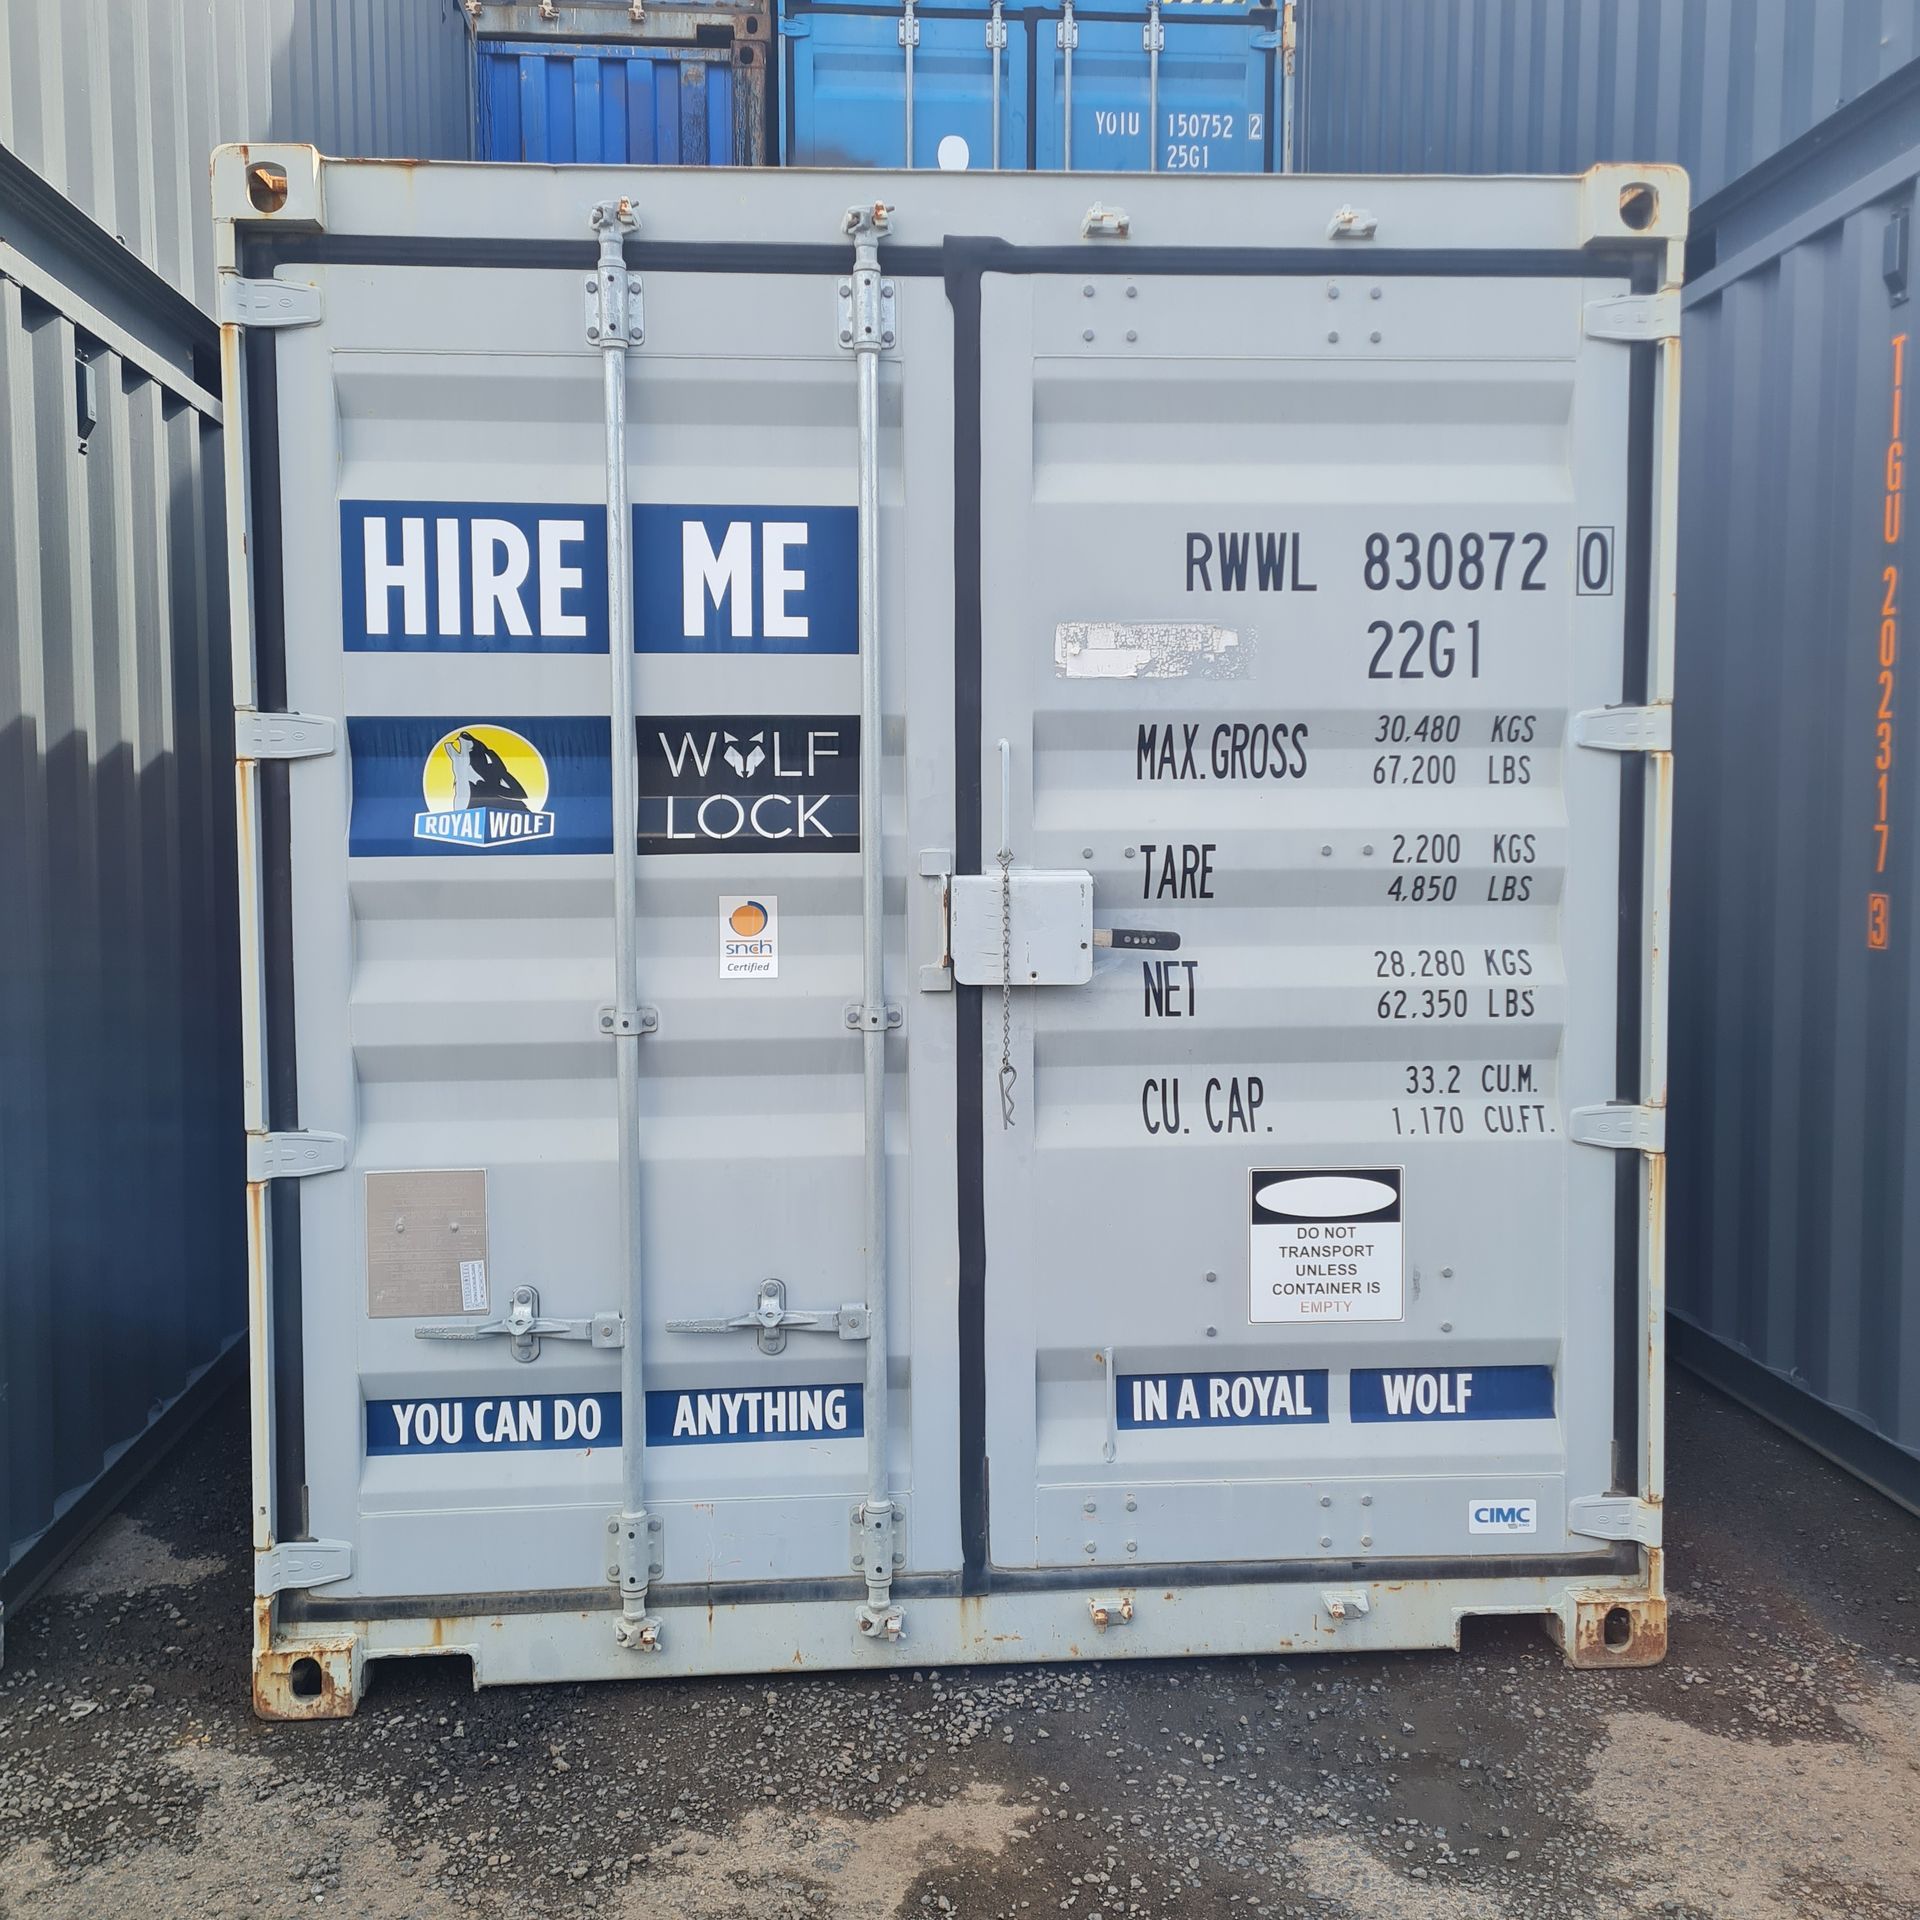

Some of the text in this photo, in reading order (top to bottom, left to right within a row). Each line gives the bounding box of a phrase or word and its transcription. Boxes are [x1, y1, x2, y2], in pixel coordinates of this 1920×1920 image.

[1096, 111, 1261, 138] YOIU 150752 2
[1167, 145, 1208, 168] 25G1
[1186, 531, 1610, 592] RWWL 830872 0
[363, 516, 809, 638] HIRE ME
[1367, 619, 1481, 680] 22G1
[1872, 333, 1908, 945] TIGU 202317 3
[1374, 715, 1461, 745] 30,480
[1491, 715, 1537, 744] KGS
[1373, 755, 1532, 786] 67,200 LBS
[425, 811, 545, 839] ROYAL WOLF
[666, 794, 833, 839] LOCK
[1139, 834, 1537, 900] TARE 2,200 KGS
[1387, 874, 1533, 903] 4,850 LBS
[726, 940, 772, 955] snch
[727, 963, 770, 972] Certified
[1142, 960, 1199, 1017] NET
[1484, 948, 1533, 977] KGS
[1487, 988, 1535, 1018] LBS
[1142, 1064, 1539, 1135] CU. CAP. 33.2 CU.M.
[1297, 1226, 1356, 1240] DO NOT
[1279, 1245, 1374, 1258] TRANSPORT
[1296, 1263, 1357, 1276] UNLESS
[1272, 1281, 1380, 1295] CONTAINER IS
[1300, 1301, 1352, 1313] EMPTY
[1132, 1373, 1472, 1421] IN A ROYAL WOLF
[393, 1389, 847, 1445] YOU CAN DO ANYTHING
[1474, 1507, 1530, 1523] CIMC
